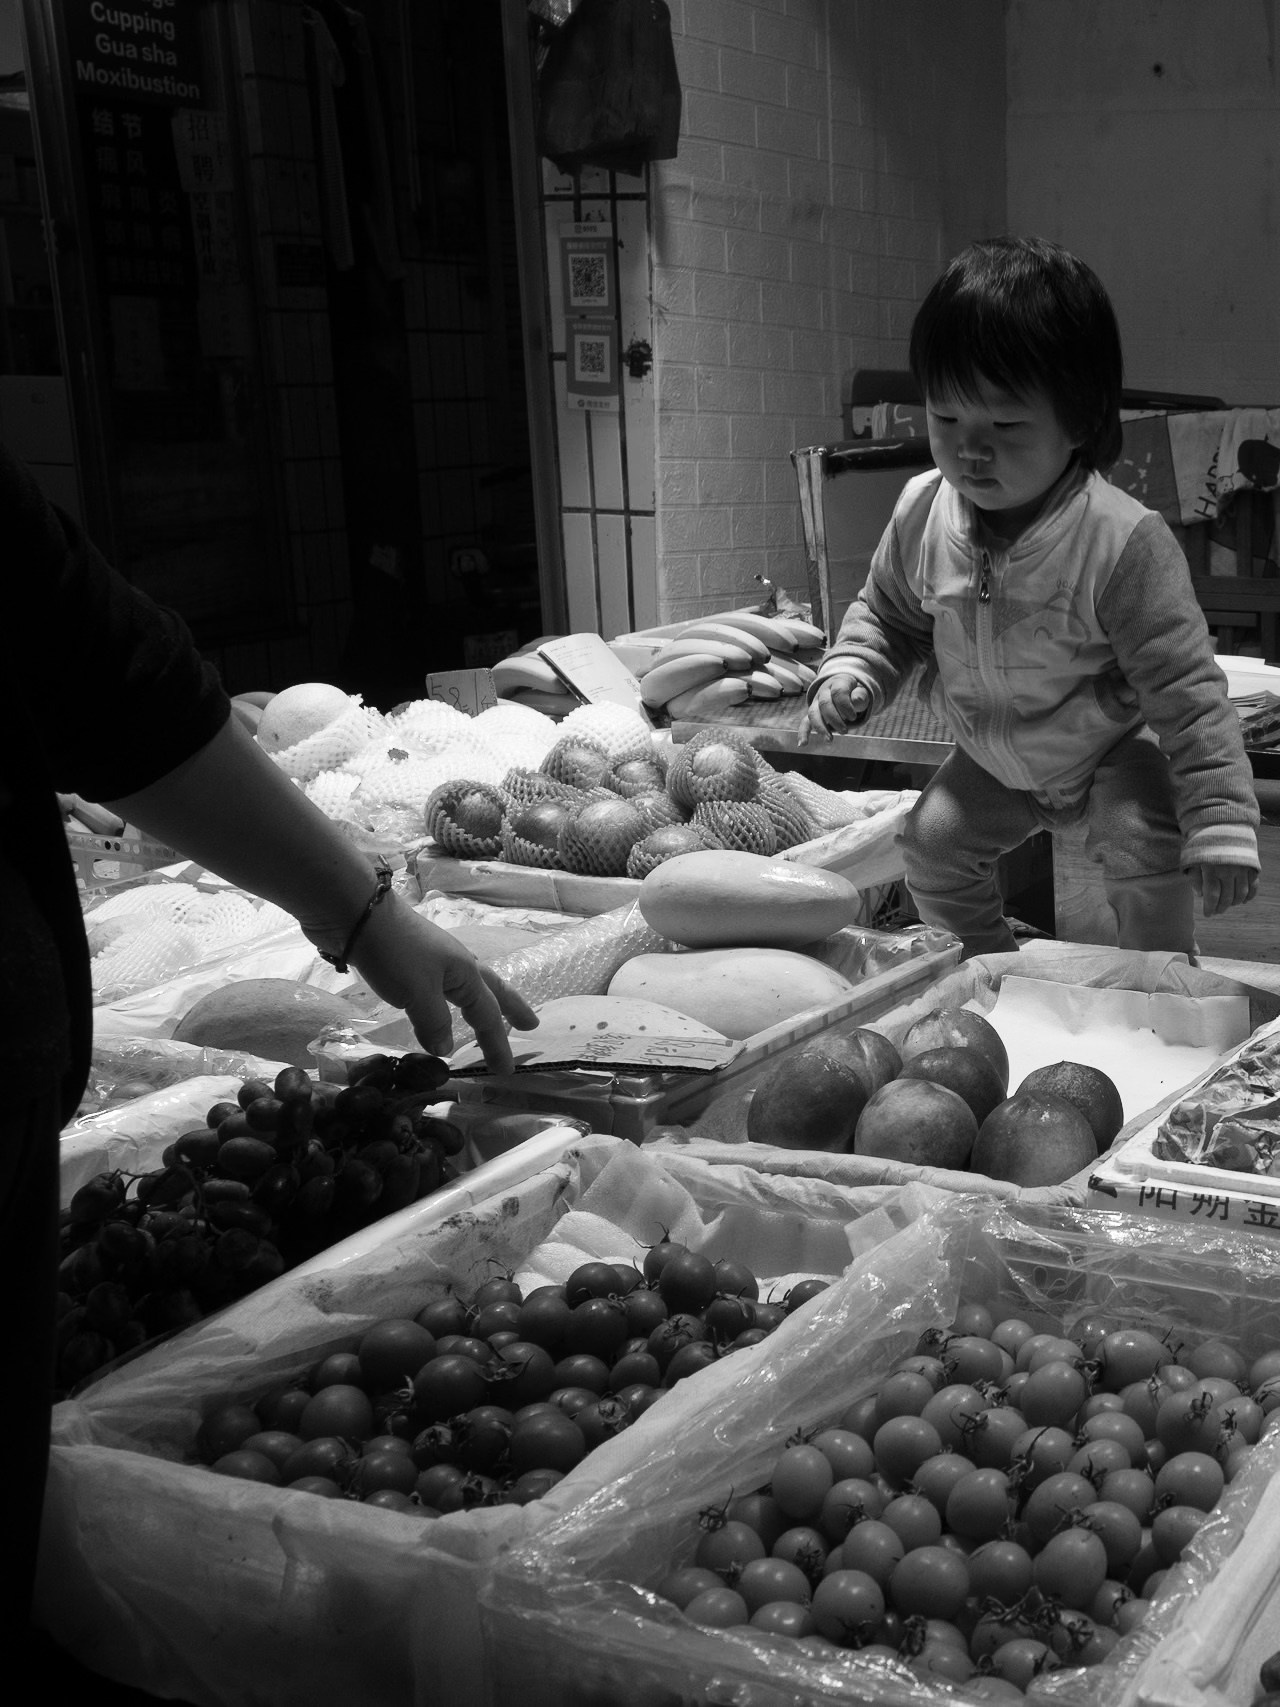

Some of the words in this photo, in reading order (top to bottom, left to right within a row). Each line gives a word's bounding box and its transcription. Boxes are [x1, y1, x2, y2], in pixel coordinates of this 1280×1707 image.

[90, 1, 175, 41] Cupping
[95, 33, 138, 60] Gua
[142, 42, 177, 67] sha
[76, 59, 201, 100] Moxibustion
[188, 113, 214, 183] 招聘
